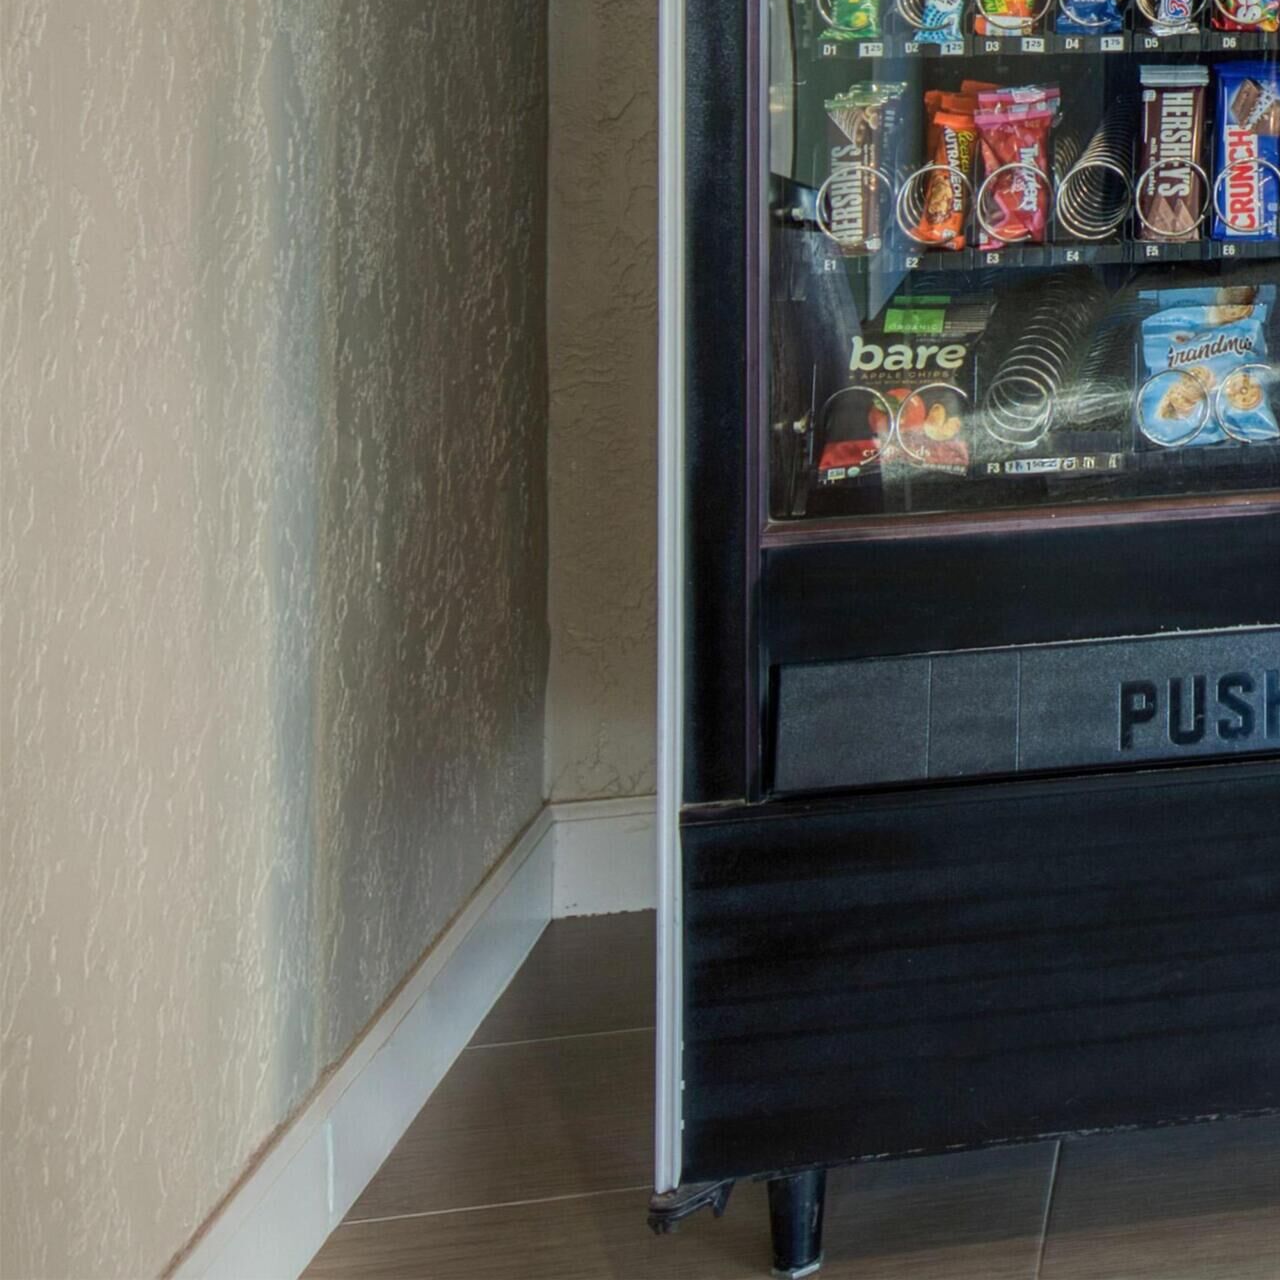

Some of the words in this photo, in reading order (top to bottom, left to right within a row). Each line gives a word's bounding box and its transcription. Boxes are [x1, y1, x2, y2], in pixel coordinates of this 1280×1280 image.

[1167, 0, 1189, 17] 3
[905, 42, 919, 53] D2
[985, 41, 999, 52] D3
[1066, 38, 1080, 49] D4
[1145, 38, 1158, 49] D5
[1223, 37, 1236, 48] D6
[823, 43, 837, 56] D1
[1158, 92, 1193, 197] HERSHEY'S
[1229, 130, 1257, 230] CRUNCH
[831, 144, 863, 243] HERSHEY'S
[1146, 245, 1159, 256] E5
[1223, 244, 1235, 255] E6
[987, 253, 999, 264] E3
[1067, 251, 1079, 261] E4
[824, 259, 836, 271] E1
[905, 257, 918, 268] E2
[849, 336, 967, 371] bare
[861, 372, 901, 380] APPLE
[908, 371, 949, 379] CHIPS
[987, 463, 1000, 474] F3
